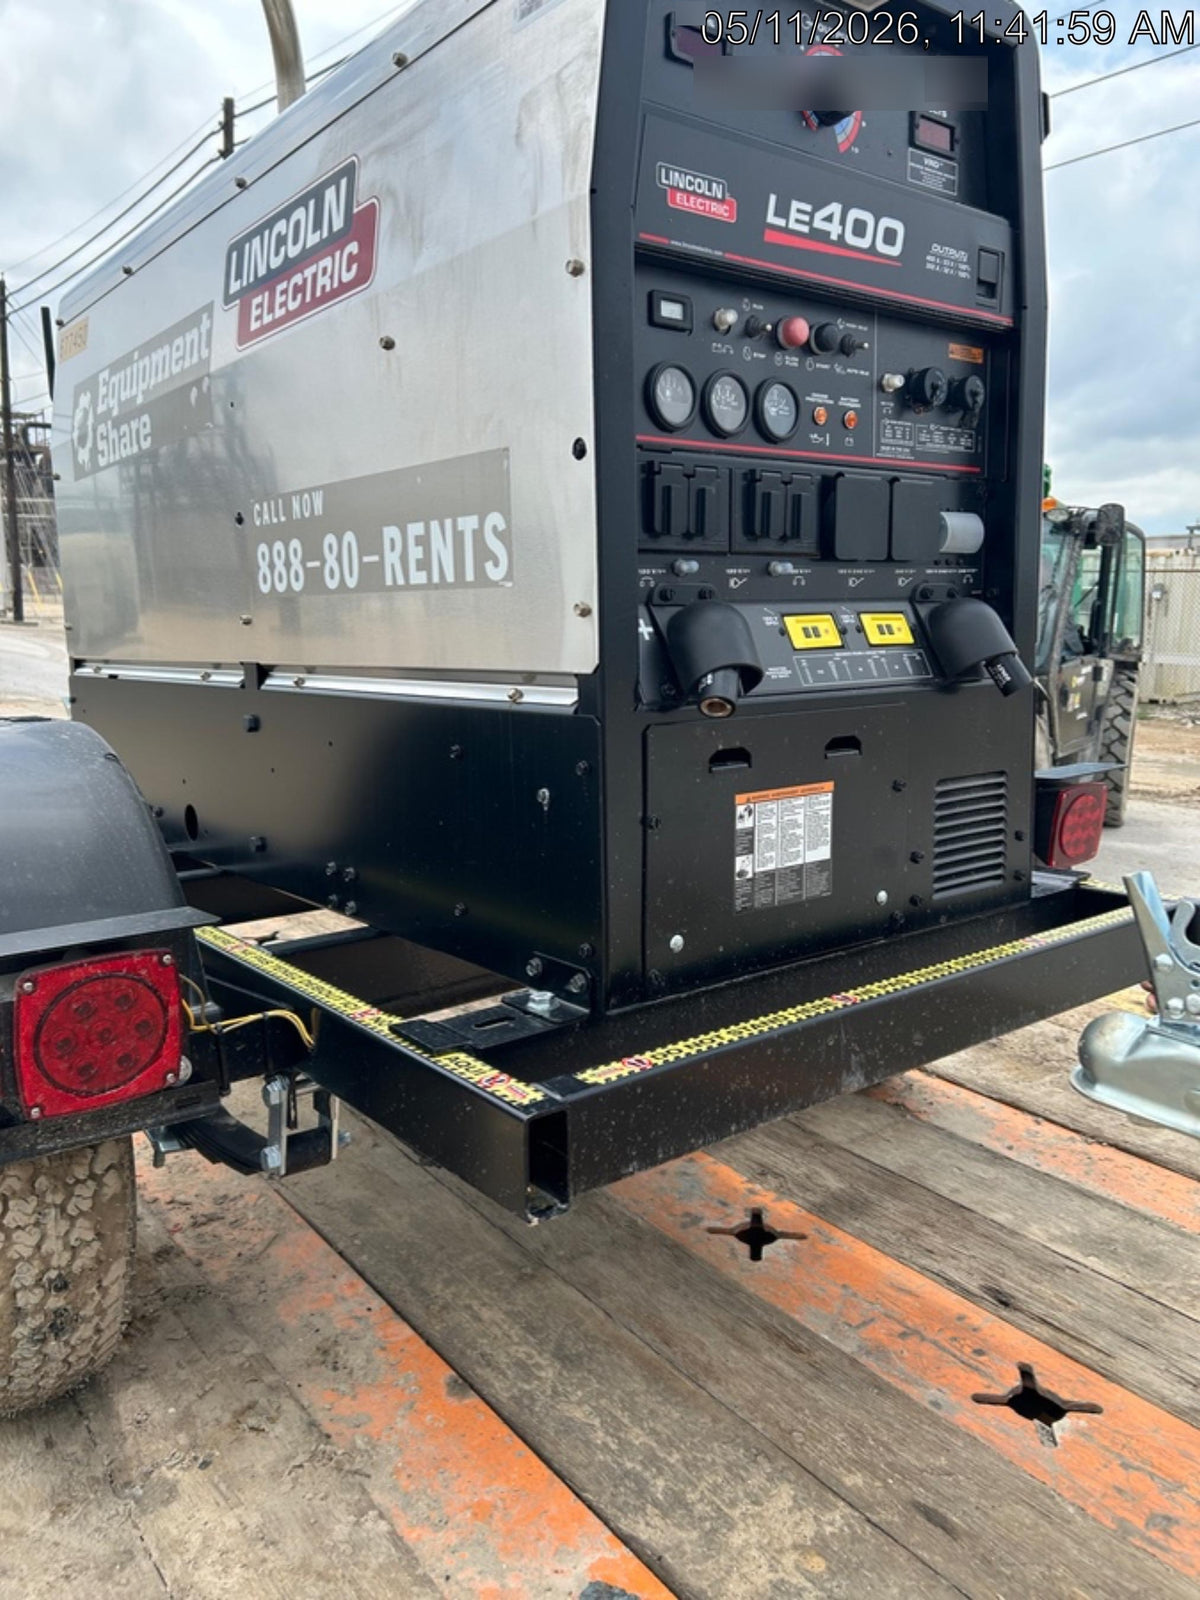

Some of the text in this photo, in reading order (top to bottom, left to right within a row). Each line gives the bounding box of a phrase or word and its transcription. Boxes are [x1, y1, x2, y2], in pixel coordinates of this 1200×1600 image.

[661, 167, 723, 200] LINCOLN
[675, 192, 730, 217] ELECTRIC
[229, 177, 347, 295] LINCOLN
[766, 193, 905, 257] LE400
[250, 241, 358, 332] ELECTRIC
[97, 311, 212, 415] Equipment
[96, 412, 151, 467] Share
[253, 490, 324, 526] CALL NOW
[257, 511, 508, 594] 888-80-RENTS
